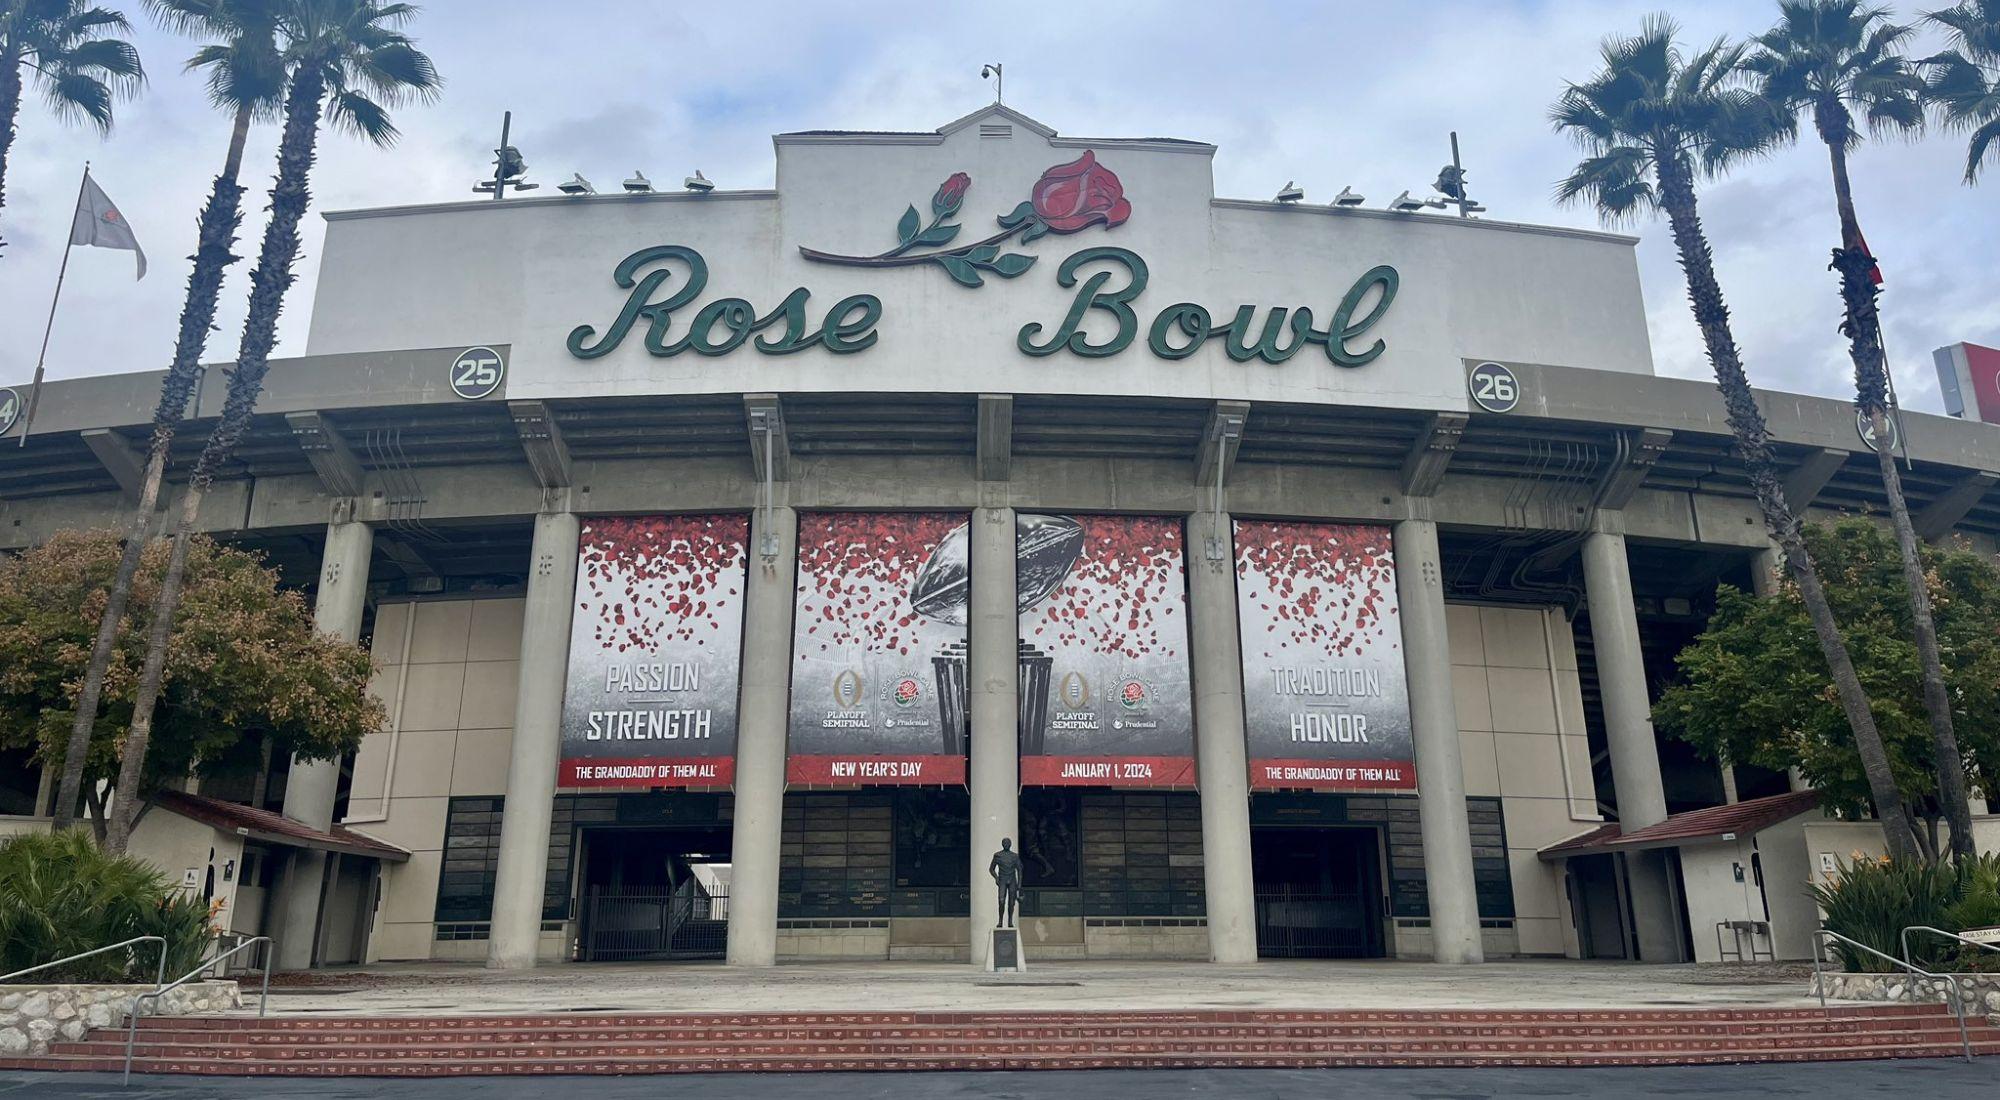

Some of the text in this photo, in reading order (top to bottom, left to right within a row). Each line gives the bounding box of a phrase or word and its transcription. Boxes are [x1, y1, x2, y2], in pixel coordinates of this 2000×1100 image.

[567, 246, 1399, 369] Rose Bowl
[455, 358, 498, 386] 25
[1475, 373, 1515, 401] 26
[606, 662, 700, 692] PASSION
[1271, 666, 1381, 697] TRADITION
[826, 710, 867, 719] PLAYOFF
[1056, 712, 1095, 721] PLAYOFF
[586, 709, 713, 740] STRENGTH
[822, 719, 870, 728] SEMIFINAL
[1052, 720, 1100, 729] SEMIFINAL
[1125, 720, 1157, 728] Prudential
[1290, 713, 1369, 743] HONOR
[575, 764, 716, 779] THE GRANDDADDY OF THEM ALL
[831, 761, 922, 777] NEW YEAR'S DAY
[1061, 762, 1152, 779] JANUARY 1, 2024
[1265, 766, 1401, 781] THE GRANDDADDY OF THEM ALL
